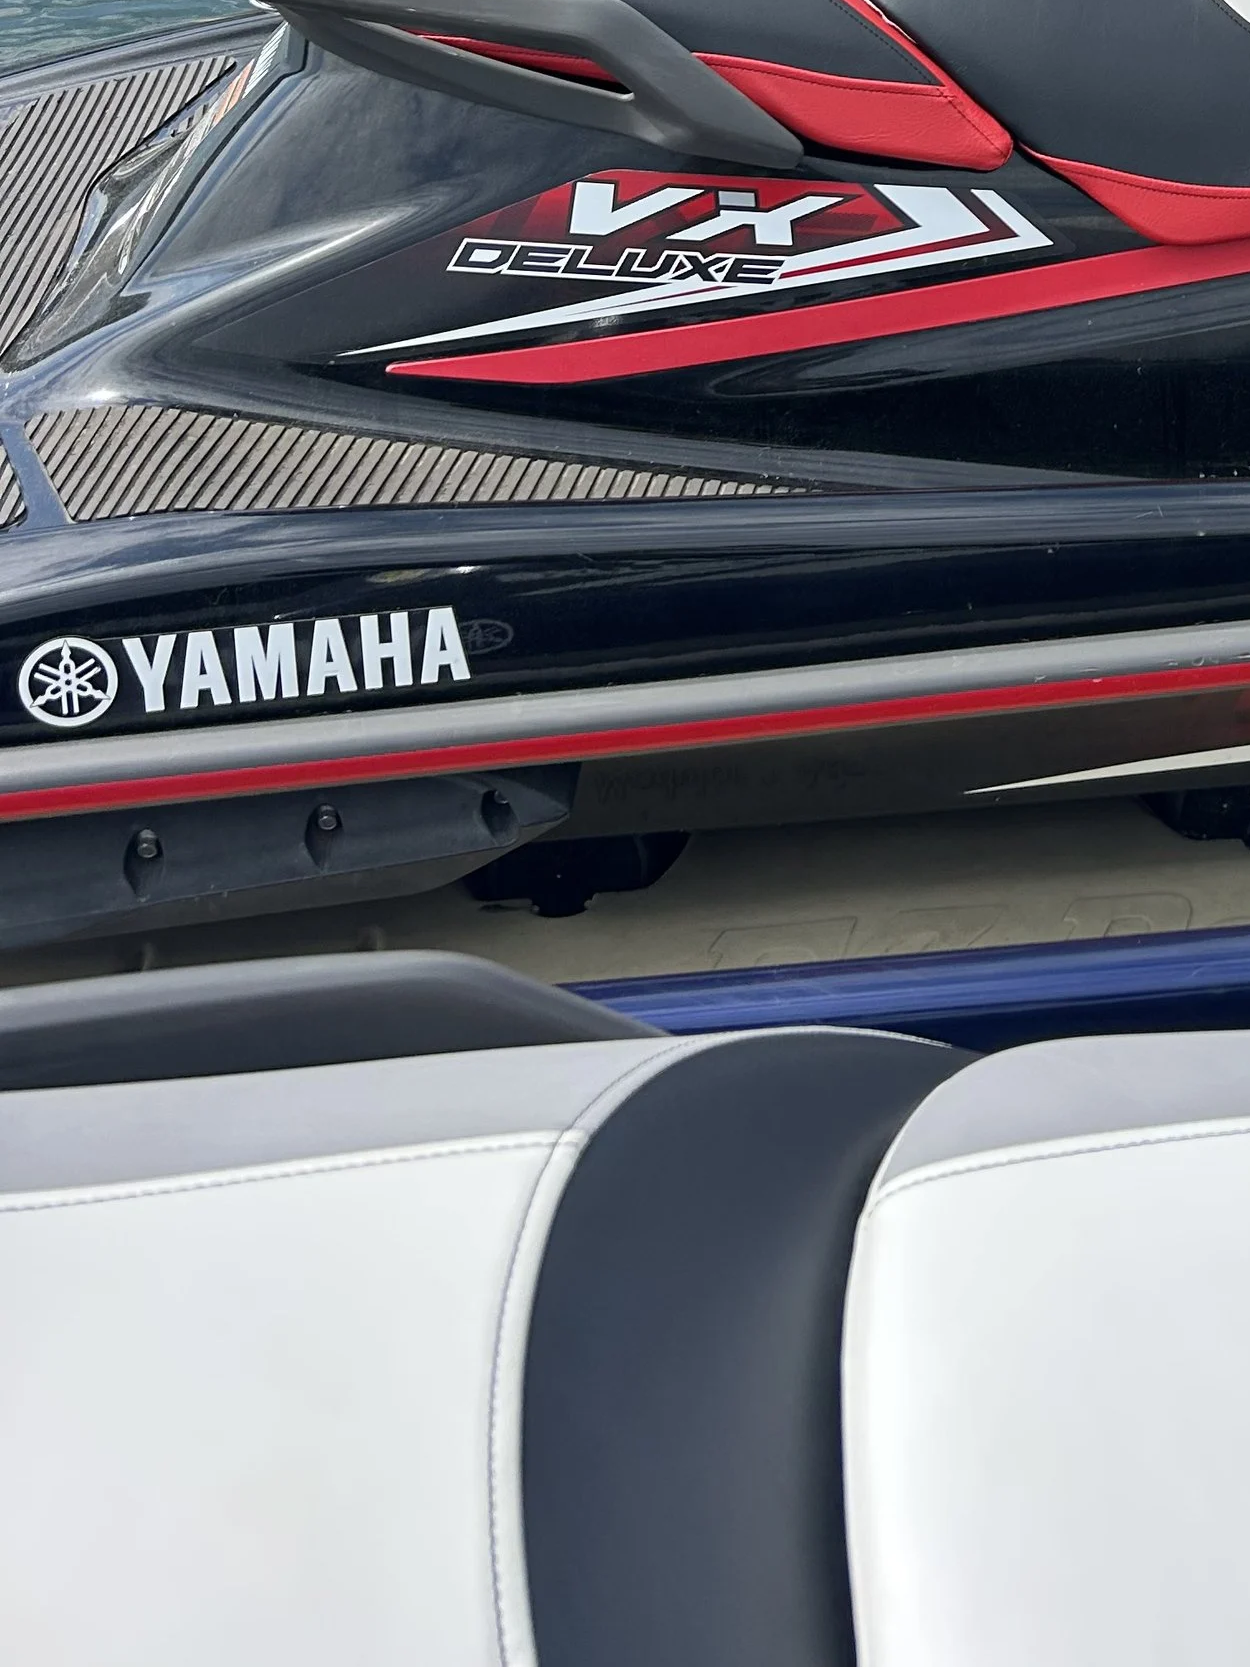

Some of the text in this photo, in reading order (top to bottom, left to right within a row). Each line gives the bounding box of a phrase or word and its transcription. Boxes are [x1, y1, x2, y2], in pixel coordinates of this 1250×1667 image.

[567, 180, 845, 248] VX
[446, 237, 794, 285] DELUXE
[122, 606, 471, 713] YAMAHA
